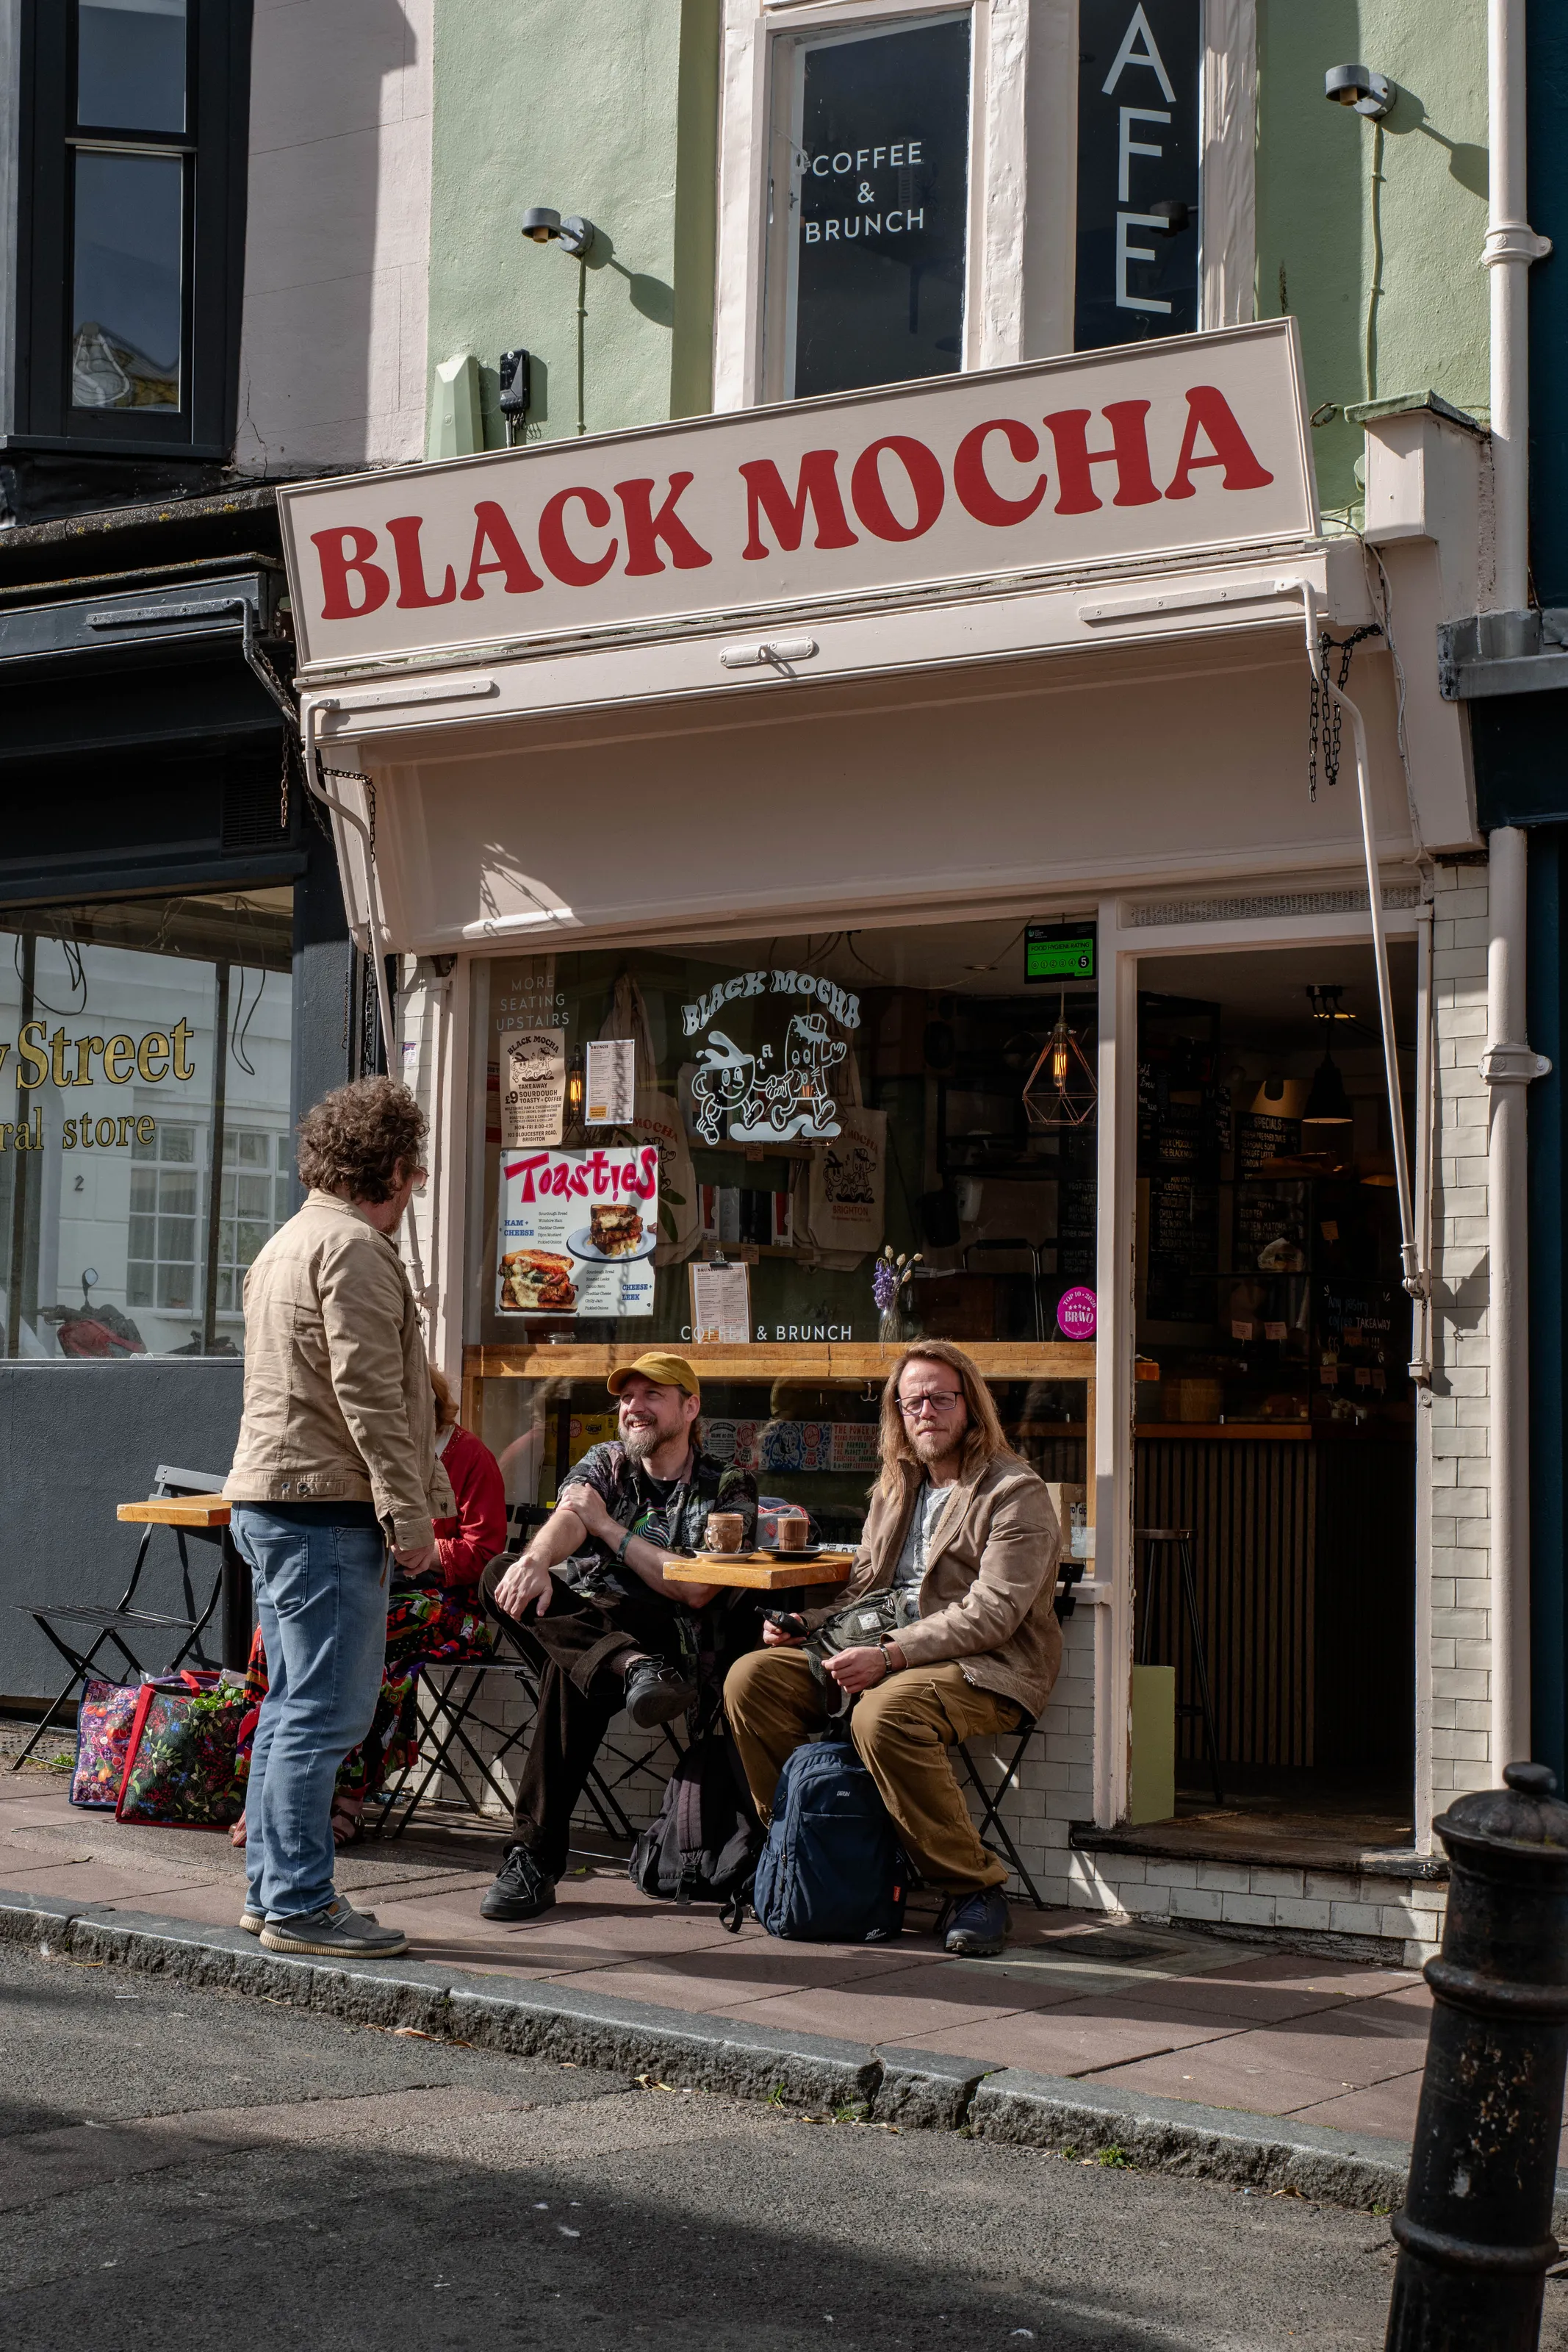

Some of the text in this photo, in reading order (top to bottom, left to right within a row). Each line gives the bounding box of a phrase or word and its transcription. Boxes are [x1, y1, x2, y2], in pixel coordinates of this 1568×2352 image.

[812, 141, 923, 176] COFFEE
[857, 182, 874, 204] &
[805, 207, 924, 244] BRUNCH
[310, 384, 1275, 620] BLACK MOCHA
[1081, 957, 1087, 967] 5
[511, 975, 554, 992] MORE
[500, 993, 565, 1011] SEATING
[681, 969, 861, 1036] BLACK MOCHA
[497, 1012, 569, 1030] UPSTAIRS
[16, 1017, 195, 1089] Street
[507, 1036, 559, 1055] BLACK MOCHA
[1139, 1076, 1156, 1089] Brew
[505, 1091, 518, 1104] £9
[62, 1112, 155, 1149] store
[1254, 1116, 1282, 1131] SPECIALS
[1241, 1148, 1260, 1158] BISCOFF
[832, 1205, 868, 1216] BRIGHTON
[1062, 1294, 1073, 1305] TOP
[1328, 1297, 1369, 1317] Any pastry
[1065, 1311, 1094, 1324] BRAVO
[1328, 1314, 1391, 1333] coffee TAKEAWAY
[680, 1325, 852, 1341] COFFEE & BRUNCH
[834, 1425, 846, 1434] THE
[849, 1425, 869, 1435] POWER
